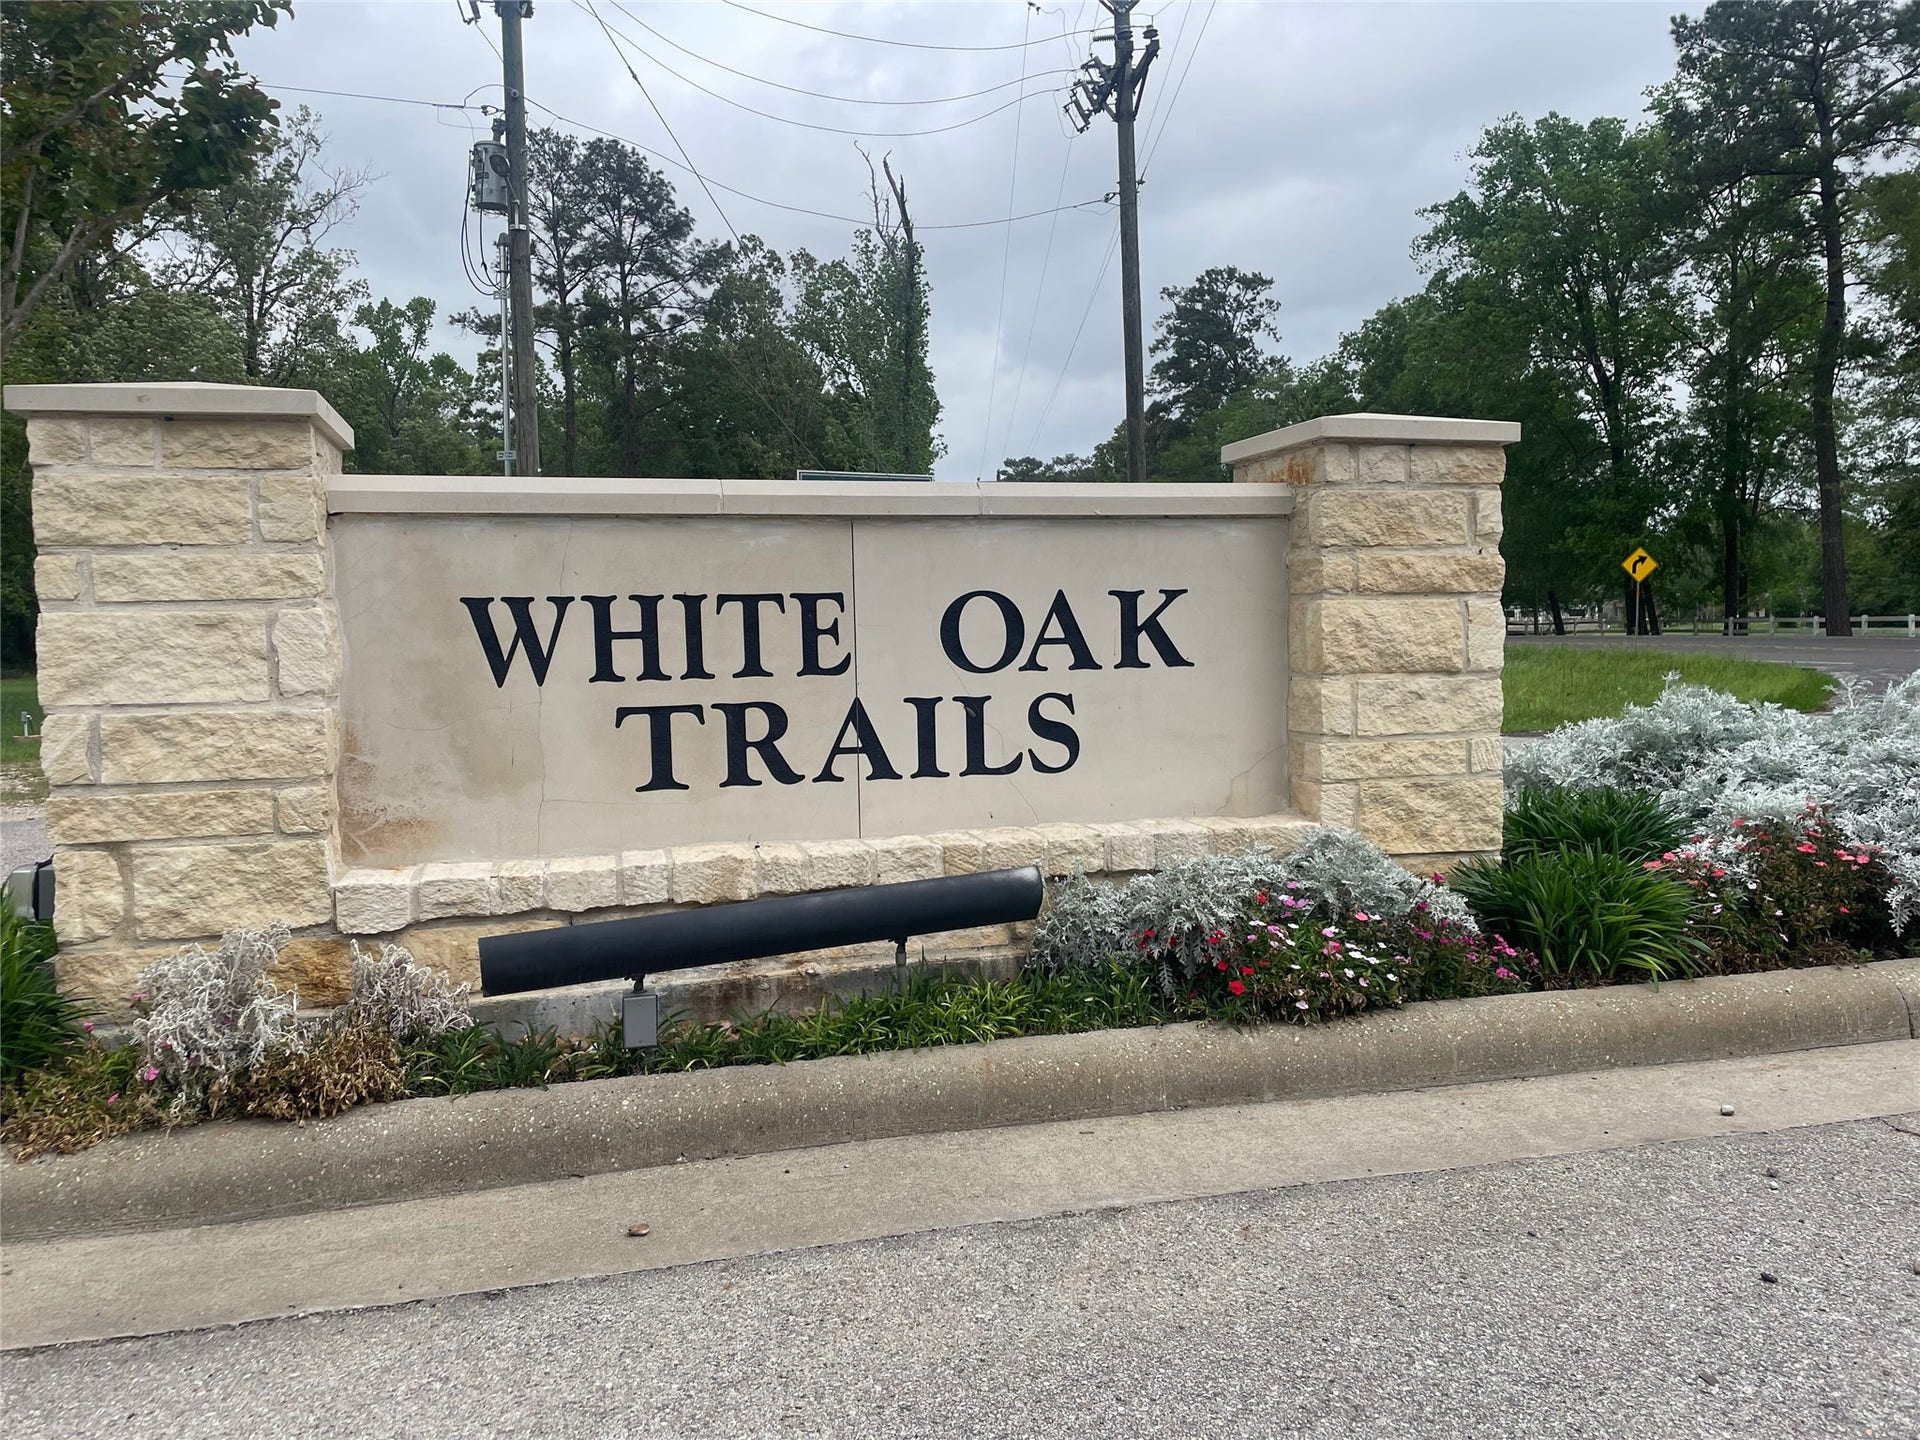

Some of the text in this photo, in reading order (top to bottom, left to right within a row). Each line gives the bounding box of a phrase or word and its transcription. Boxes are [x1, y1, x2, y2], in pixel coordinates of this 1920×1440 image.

[460, 588, 1195, 688] WHITE OAK
[615, 692, 1080, 792] TRAILS
